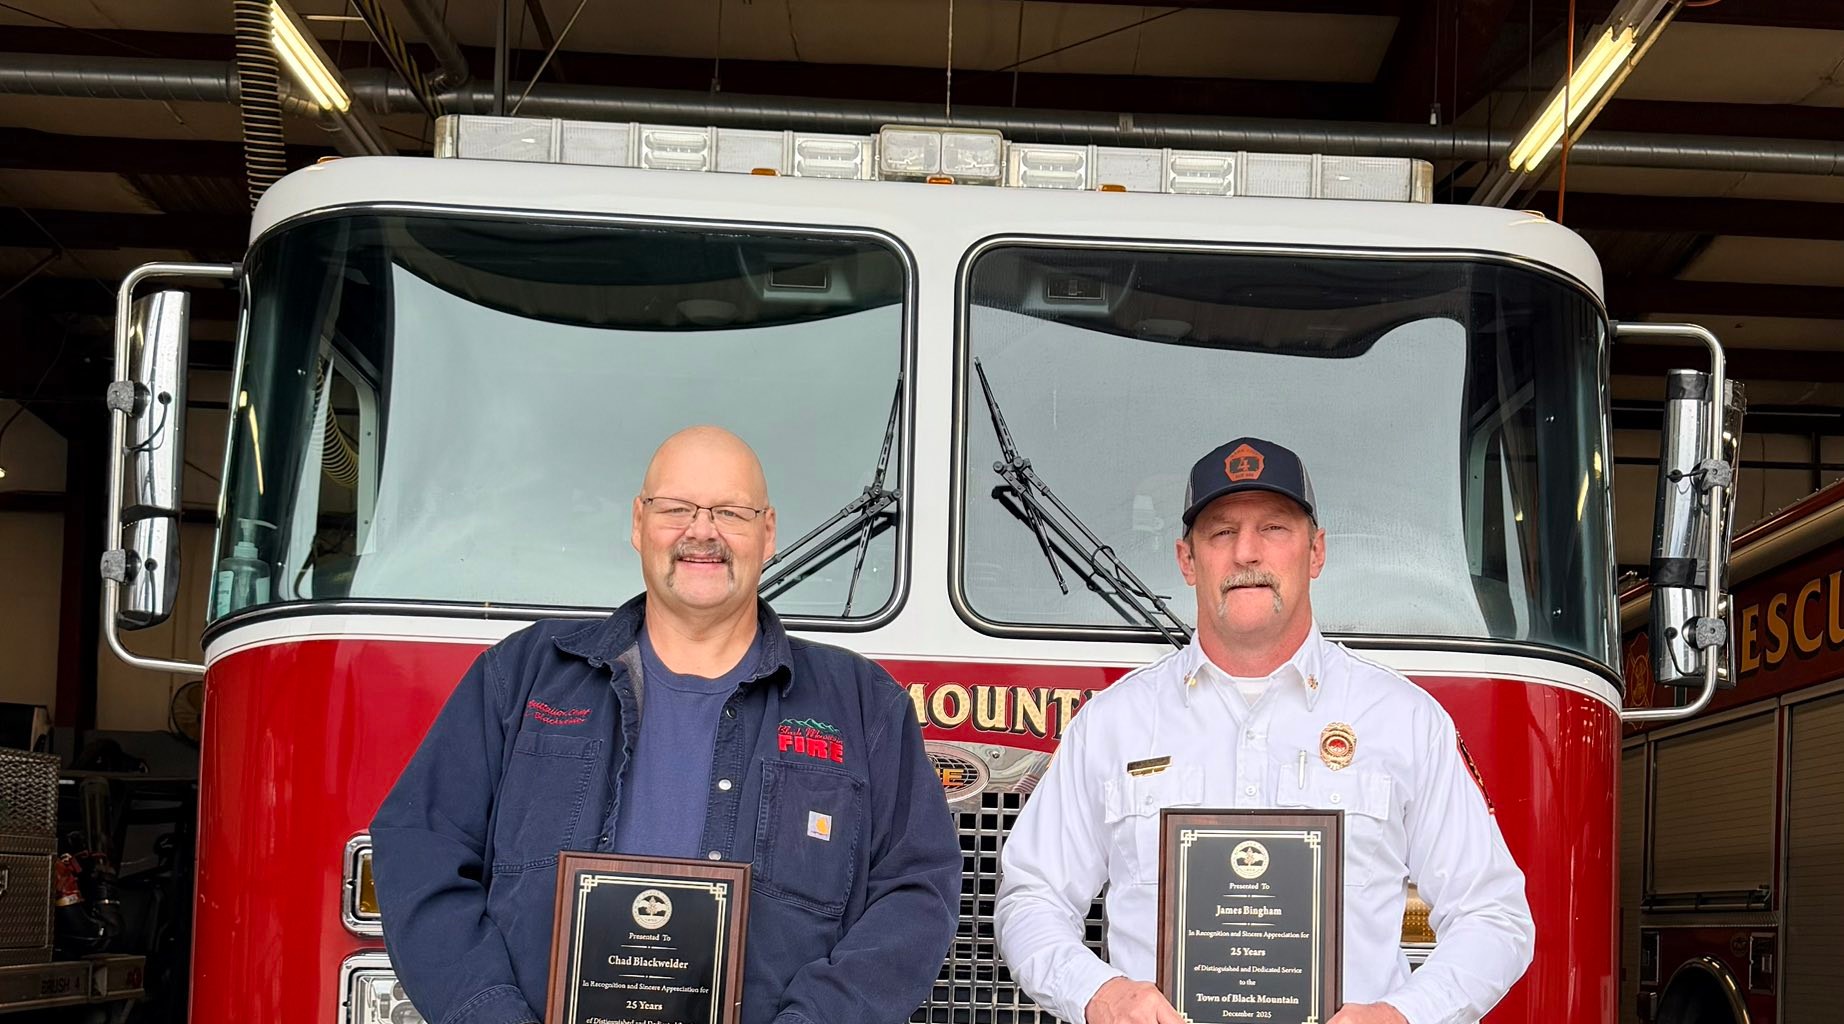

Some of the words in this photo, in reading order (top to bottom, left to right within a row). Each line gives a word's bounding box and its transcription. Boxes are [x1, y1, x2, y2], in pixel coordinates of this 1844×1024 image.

[905, 682, 1103, 738] OUNT
[778, 734, 844, 763] FIRE
[1215, 905, 1242, 916] James
[1243, 906, 1282, 917] Bingham
[629, 932, 659, 941] Presented
[1196, 930, 1229, 939] Recognition
[1264, 932, 1299, 940] Appreciation
[1231, 948, 1241, 956] 25
[1243, 948, 1266, 956] Years
[608, 956, 632, 966] Chad
[633, 956, 688, 969] Blackwelder
[1201, 965, 1239, 973] Distinguished
[590, 981, 626, 990] Recognition
[639, 983, 660, 991] Sincere
[661, 985, 699, 993] Appreciation
[1196, 994, 1220, 1002] Town
[1222, 994, 1232, 1003] of
[1232, 994, 1256, 1003] Black
[1257, 996, 1299, 1004] Mountain
[626, 1001, 637, 1009] 25
[639, 1001, 663, 1010] Years
[1223, 1010, 1254, 1018] December
